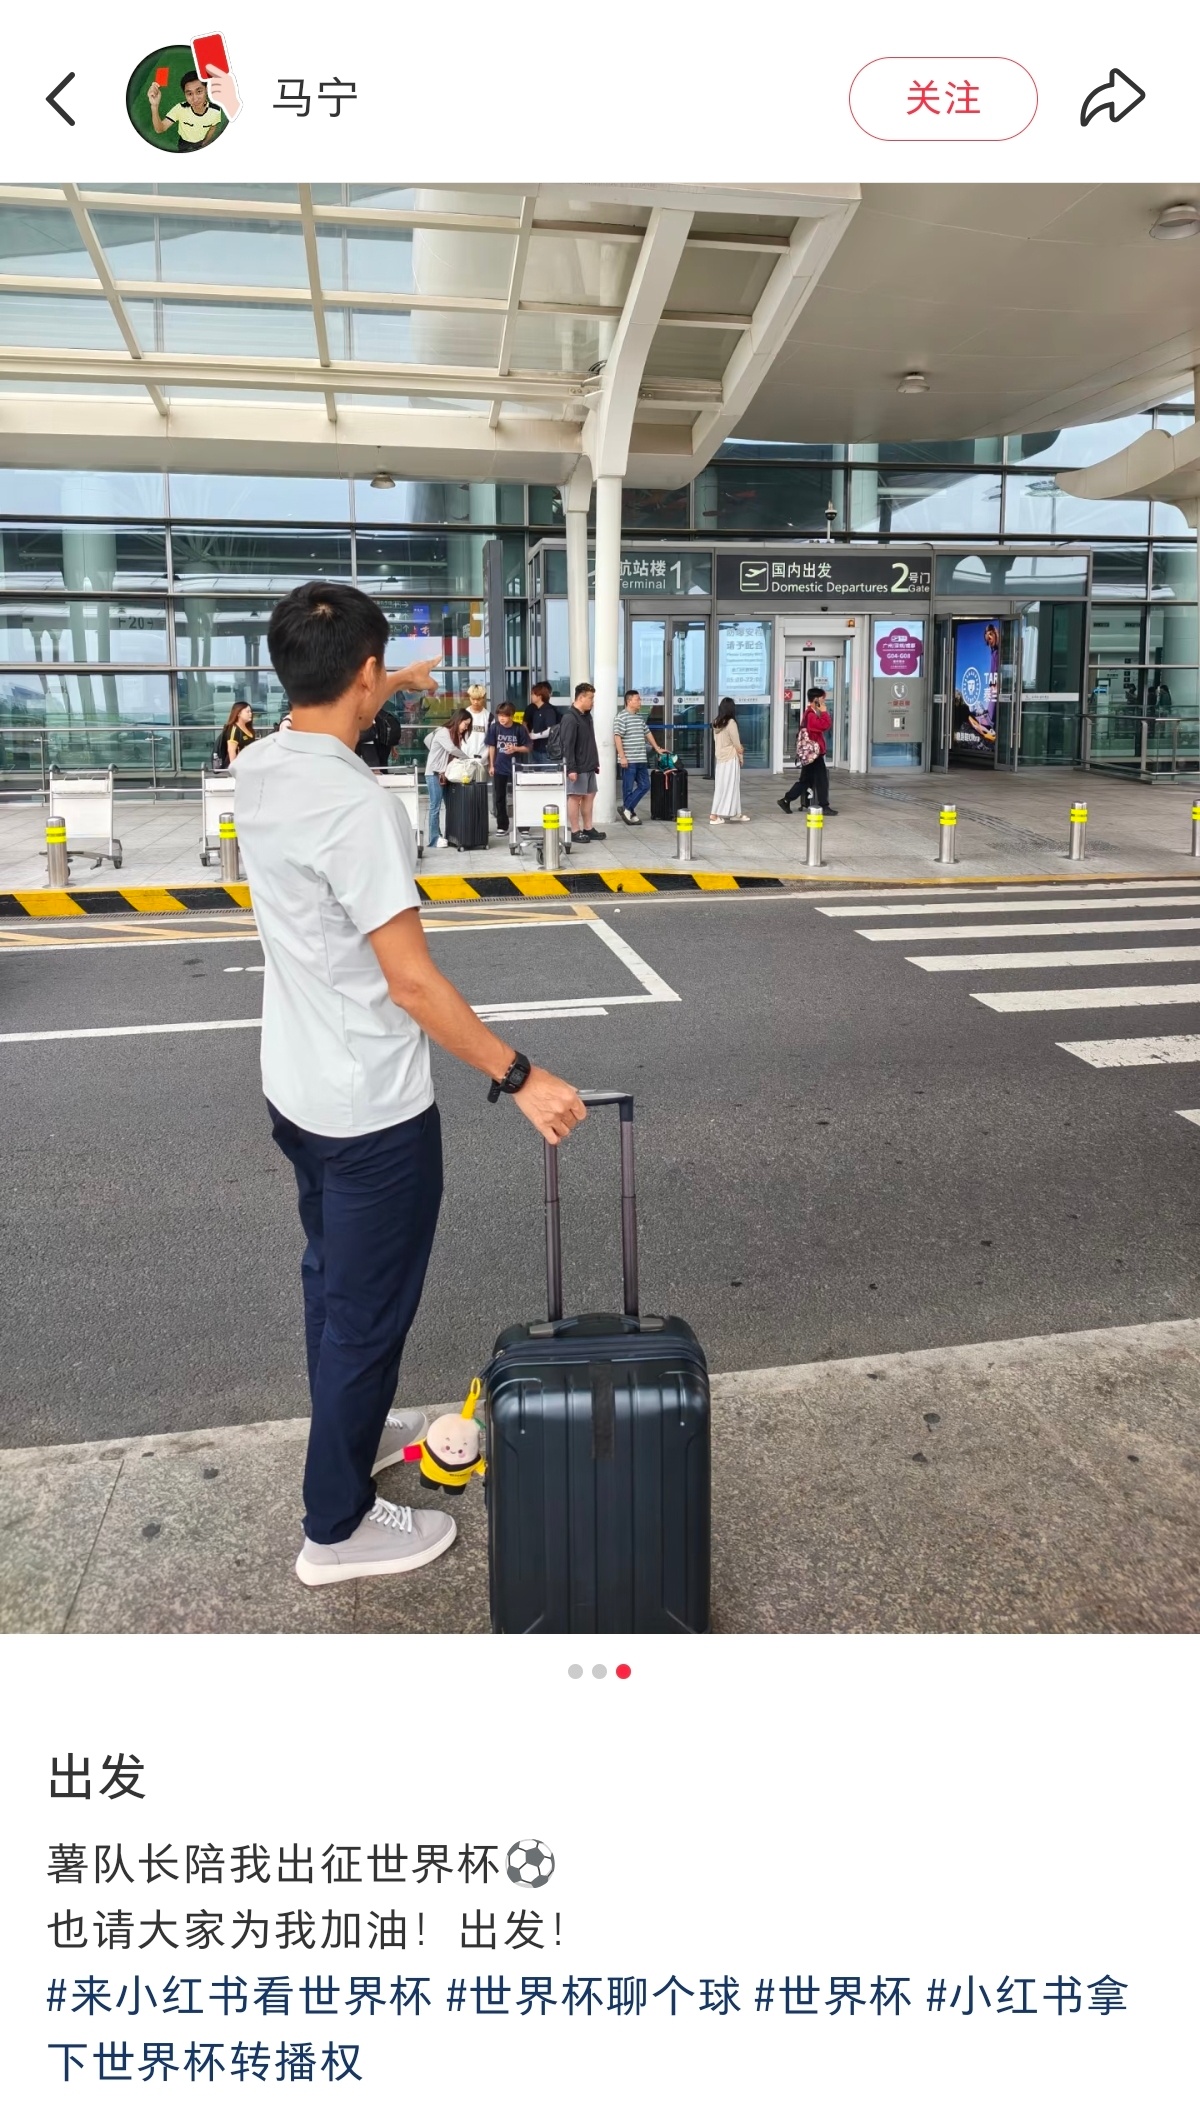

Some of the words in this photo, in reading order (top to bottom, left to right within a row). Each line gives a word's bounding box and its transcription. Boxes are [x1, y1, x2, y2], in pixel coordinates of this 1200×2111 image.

[670, 560, 681, 589] 1
[771, 562, 832, 578] 国内出发
[890, 562, 909, 593] 2
[908, 572, 931, 584] 号门
[619, 578, 666, 589] erminal
[771, 581, 823, 593] Domestic
[826, 581, 888, 595] Departures
[908, 584, 930, 593] Gate
